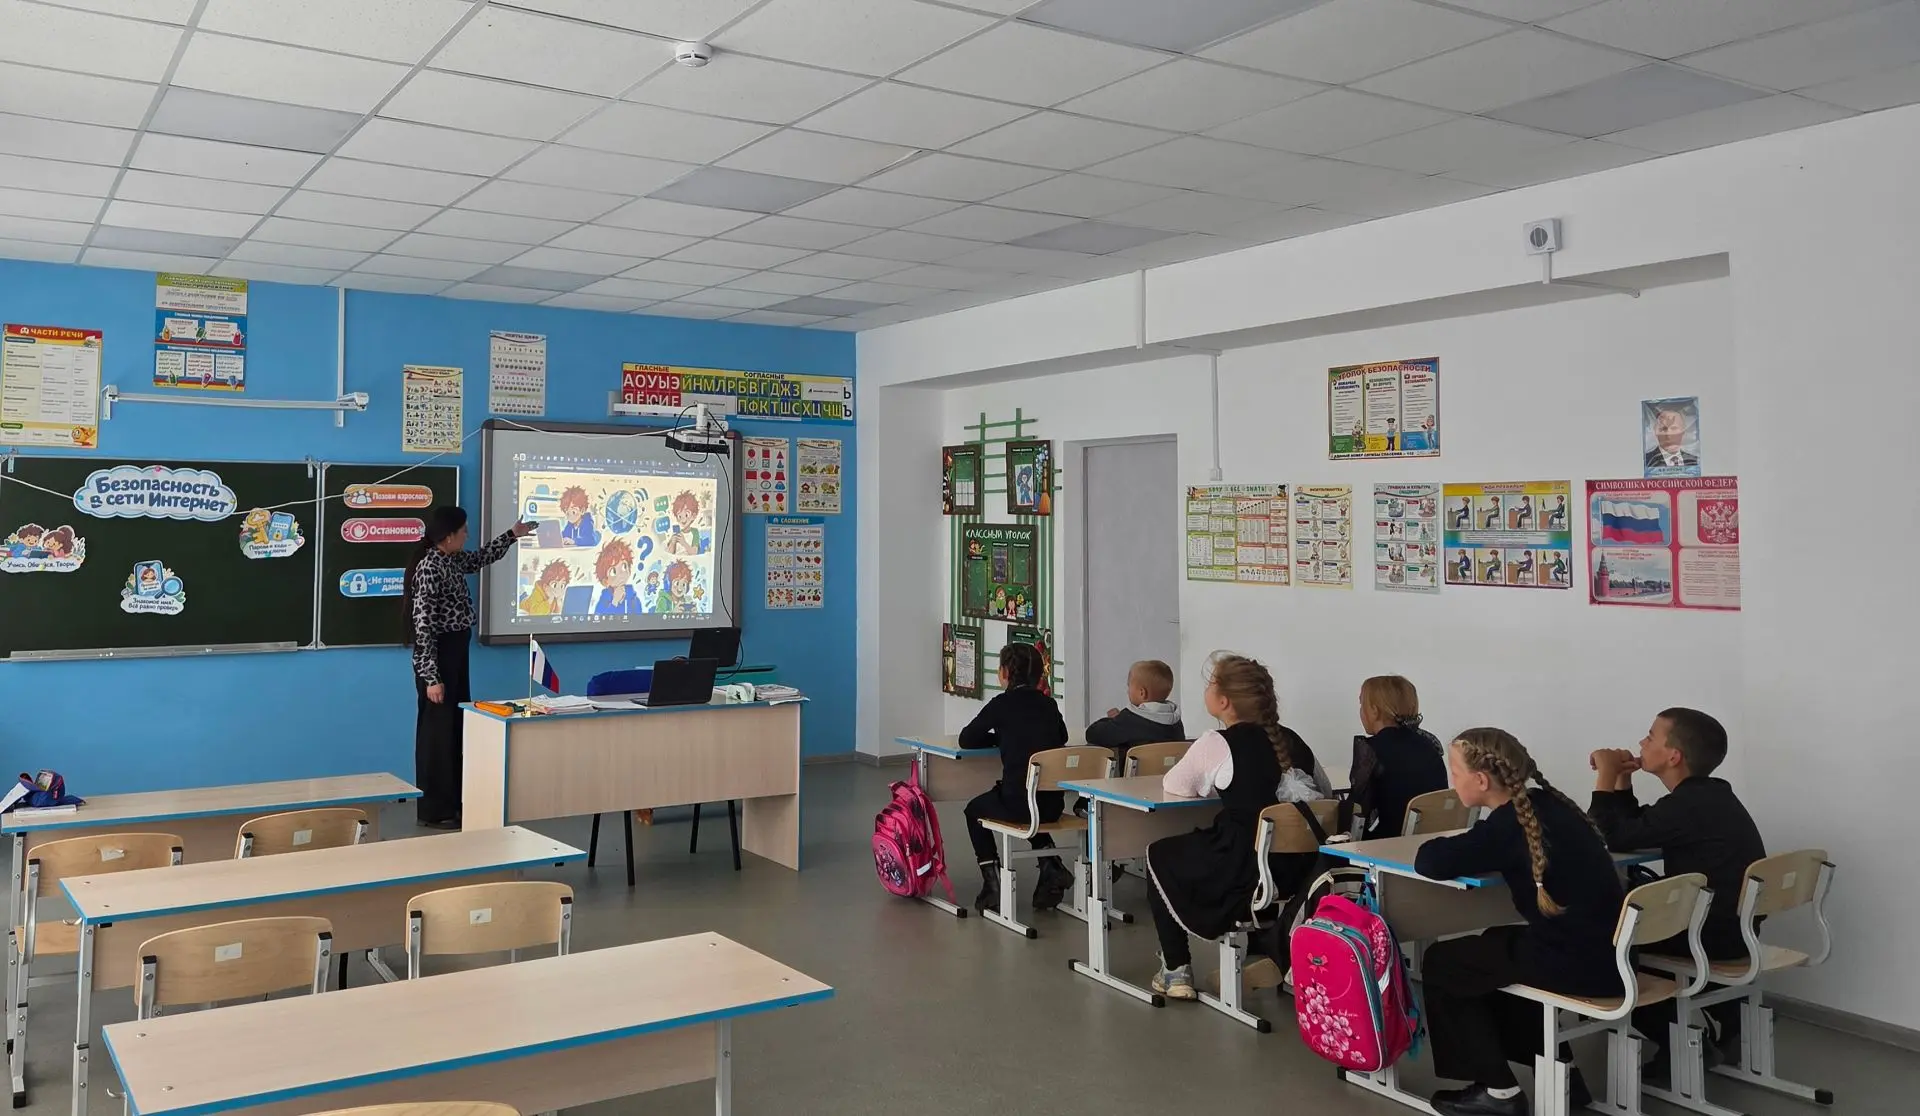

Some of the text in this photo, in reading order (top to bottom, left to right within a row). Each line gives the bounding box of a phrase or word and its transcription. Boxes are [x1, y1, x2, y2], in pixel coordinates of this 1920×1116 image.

[31, 328, 84, 338] ЧАСТИ РЕЧИ
[635, 364, 670, 372] ГЛАСНЫЕ
[1338, 364, 1431, 380] УГОЛОК БЕЗОПАСНОСТИ
[744, 371, 785, 380] СОГЛАСНЫЕ
[95, 476, 220, 497] Безопасность
[1595, 481, 1645, 490] СИМВОЛИКА
[1646, 479, 1703, 490] РОССИЙСКОЙ
[372, 492, 396, 500] Позови
[106, 493, 144, 505] сети
[149, 492, 229, 512] Интернет
[966, 529, 1032, 540] КЛАССНЫЙ УГОЛОК
[371, 576, 382, 584] Не
